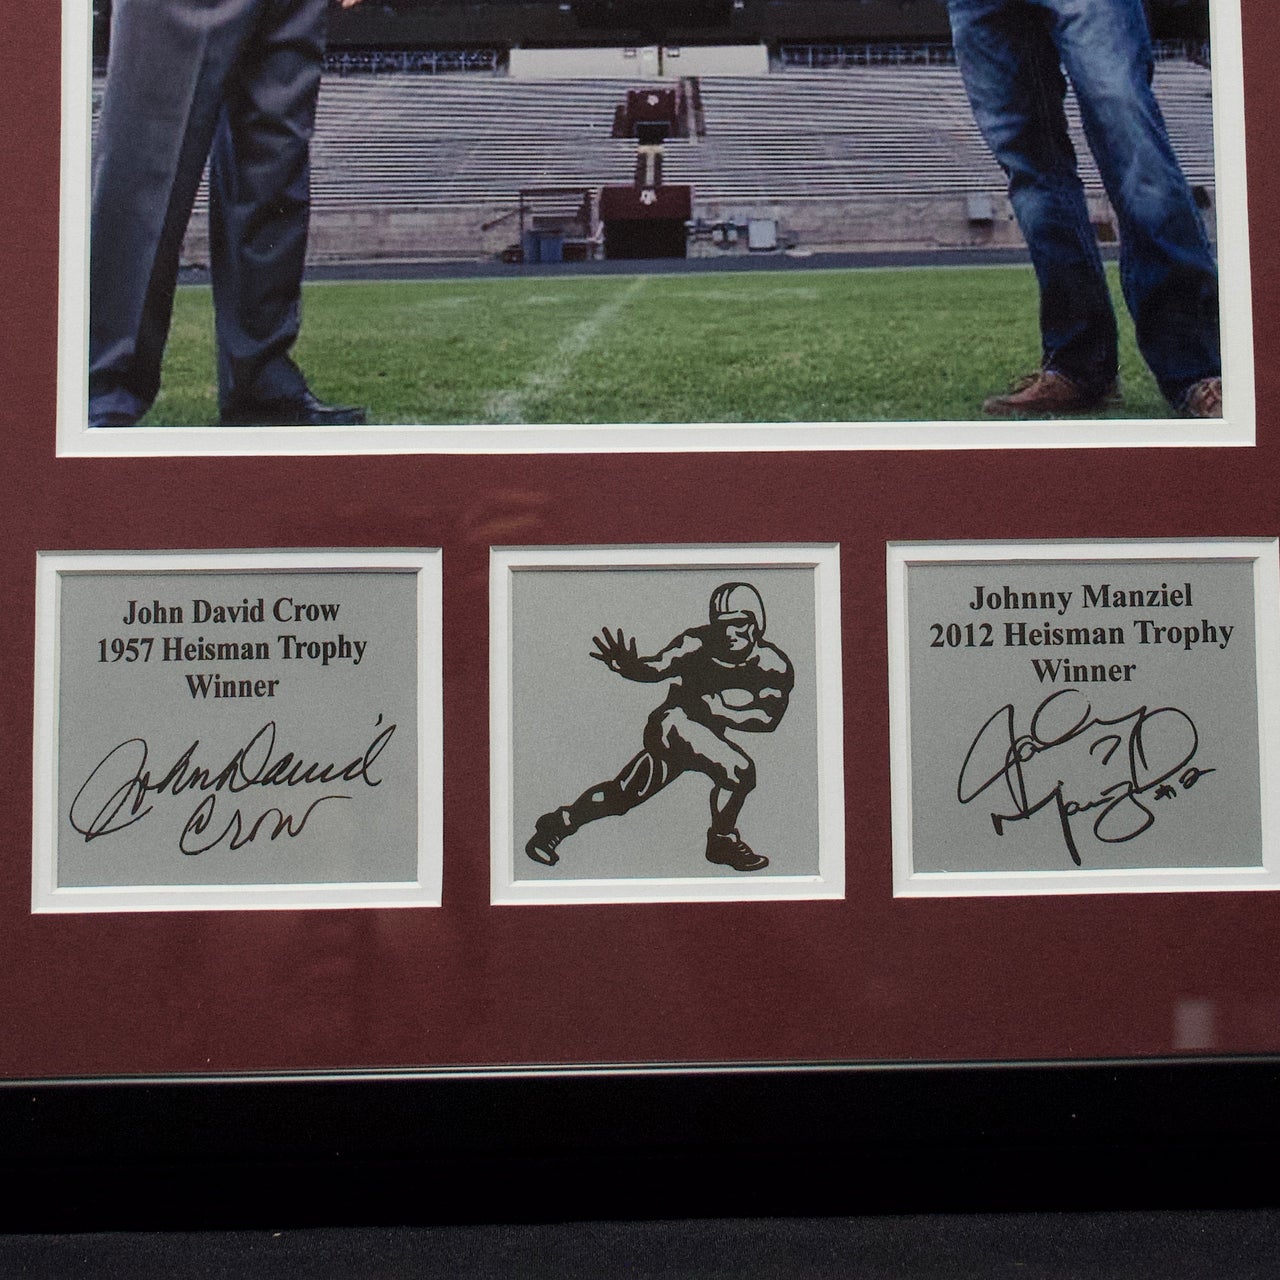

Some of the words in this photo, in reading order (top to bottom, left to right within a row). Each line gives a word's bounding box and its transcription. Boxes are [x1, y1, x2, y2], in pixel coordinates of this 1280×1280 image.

[122, 600, 184, 625] John
[192, 598, 265, 624] David
[272, 597, 341, 622] Crow
[969, 585, 1073, 615] Johnny
[1082, 583, 1193, 608] Manziel
[929, 623, 994, 648] 2012
[1003, 621, 1125, 647] Heisman
[1133, 619, 1235, 650] Trophy
[97, 638, 155, 663] 1957
[162, 636, 270, 661] Heisman
[277, 634, 368, 666] Trophy
[1031, 658, 1137, 683] Winner
[185, 674, 280, 699] Winner
